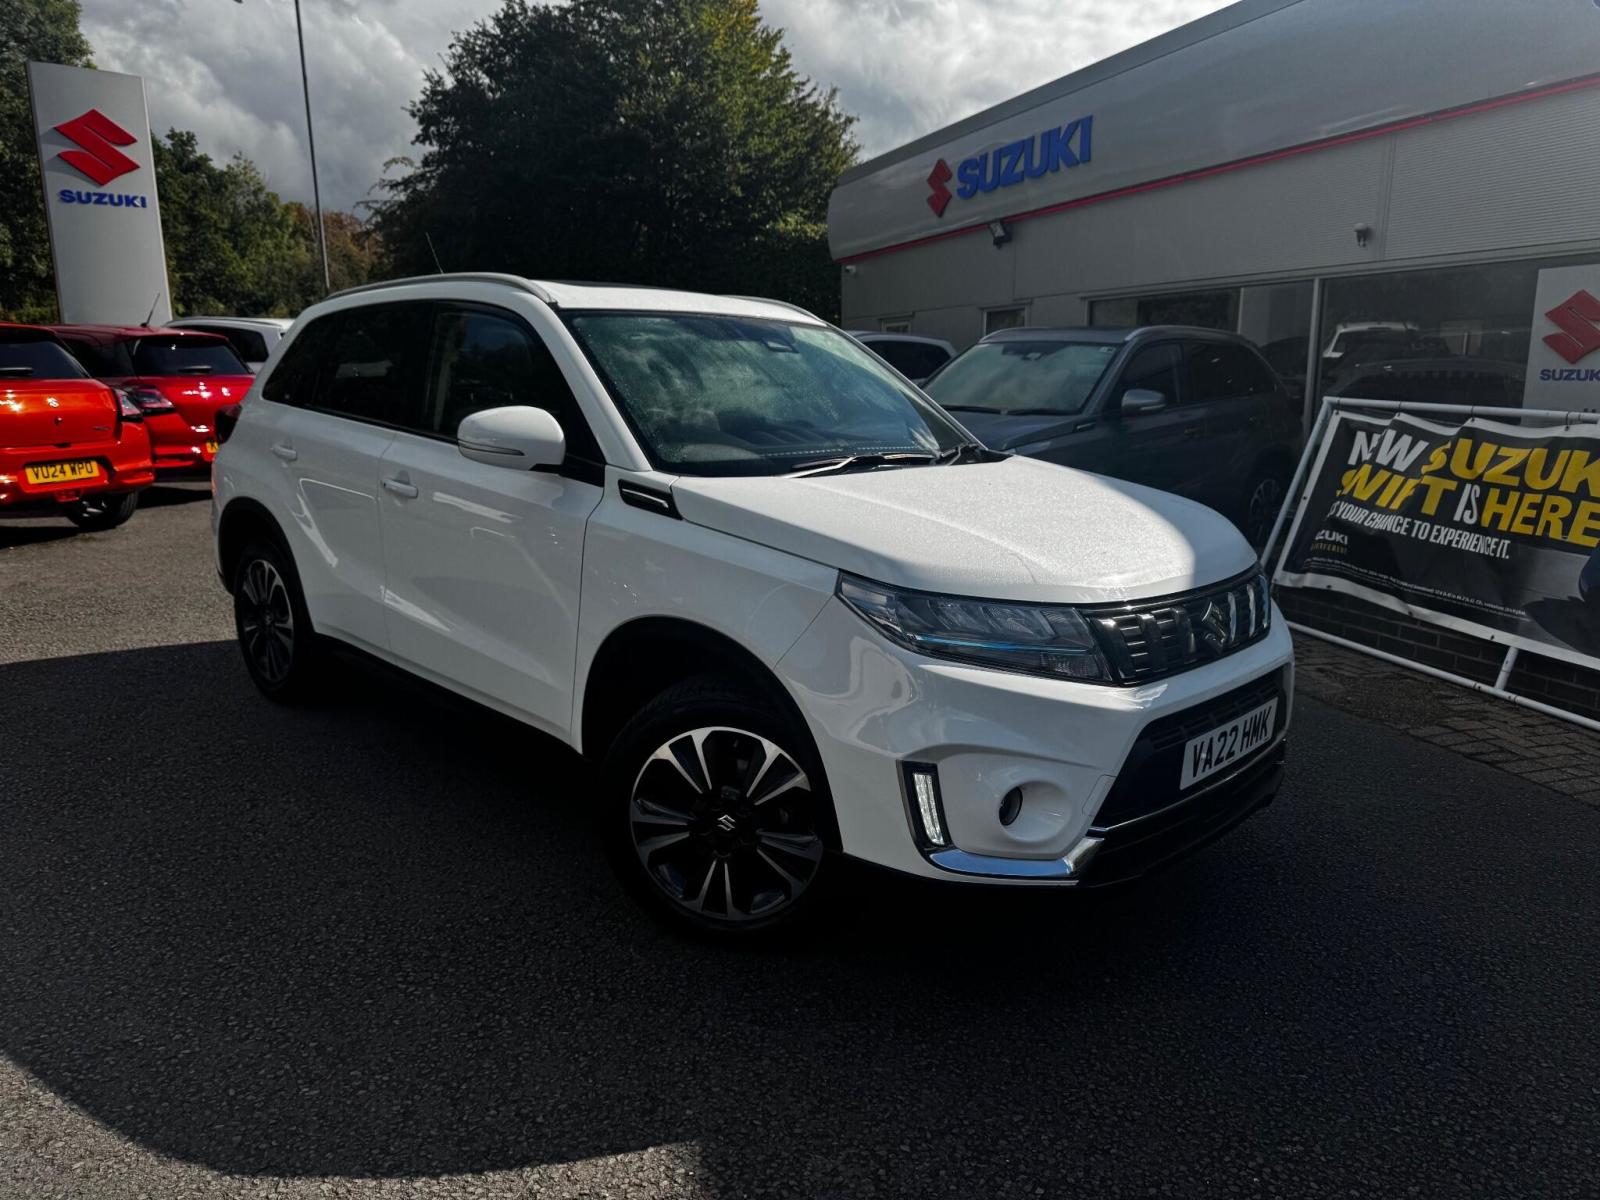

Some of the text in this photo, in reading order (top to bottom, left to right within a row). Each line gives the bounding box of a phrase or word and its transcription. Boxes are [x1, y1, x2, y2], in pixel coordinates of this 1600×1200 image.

[957, 115, 1093, 199] SUZUKI
[58, 189, 147, 208] SUZUKI
[1347, 428, 1430, 472] NW
[1335, 501, 1370, 524] YOUR
[1410, 520, 1431, 540] TO
[1428, 524, 1498, 557] EXPERIENCE
[1453, 483, 1480, 524] IS
[1480, 487, 1600, 547] HERE
[1192, 705, 1273, 778] VA22 HMK
